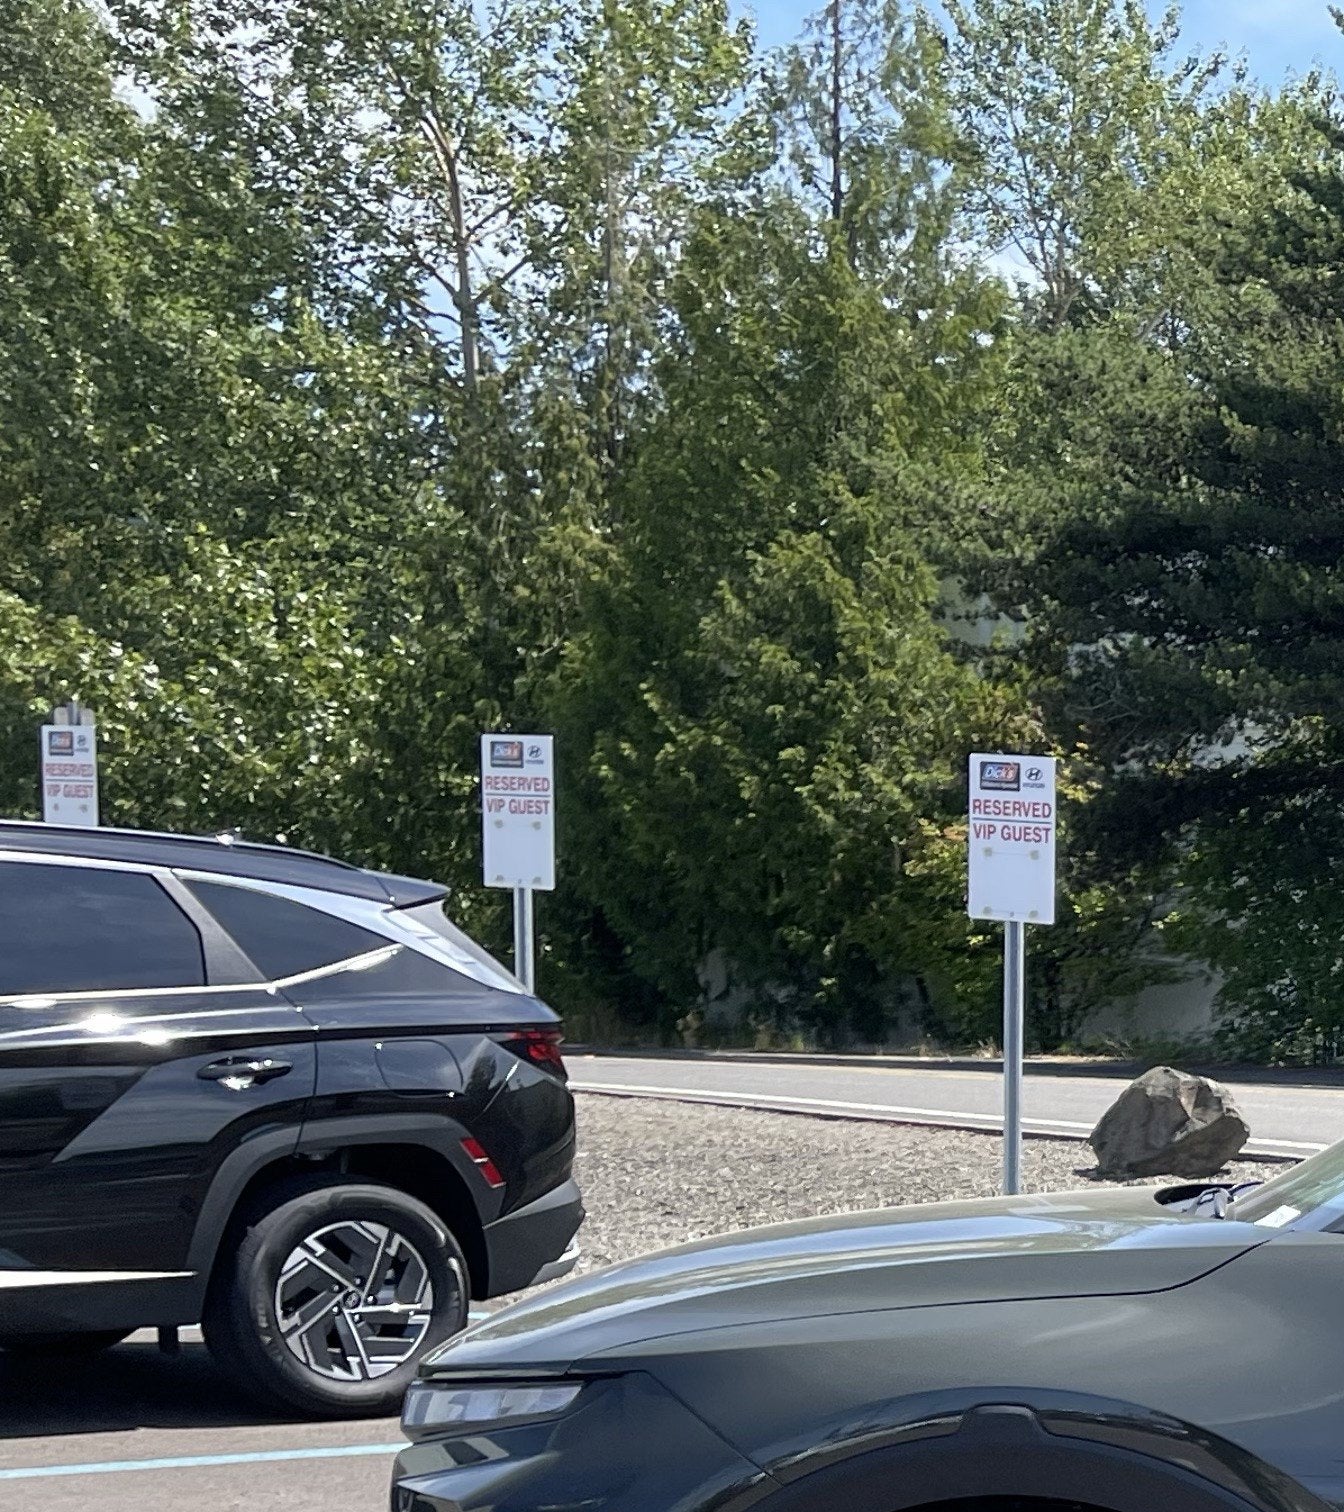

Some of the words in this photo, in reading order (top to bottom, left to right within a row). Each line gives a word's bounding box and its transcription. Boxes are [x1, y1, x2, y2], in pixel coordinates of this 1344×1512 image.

[485, 776, 550, 792] RESERVED
[486, 799, 506, 813] VIP
[508, 799, 550, 815] GUEST
[973, 799, 1052, 819] RESERVED
[973, 822, 997, 840] VIP
[1000, 824, 1052, 844] GUEST
